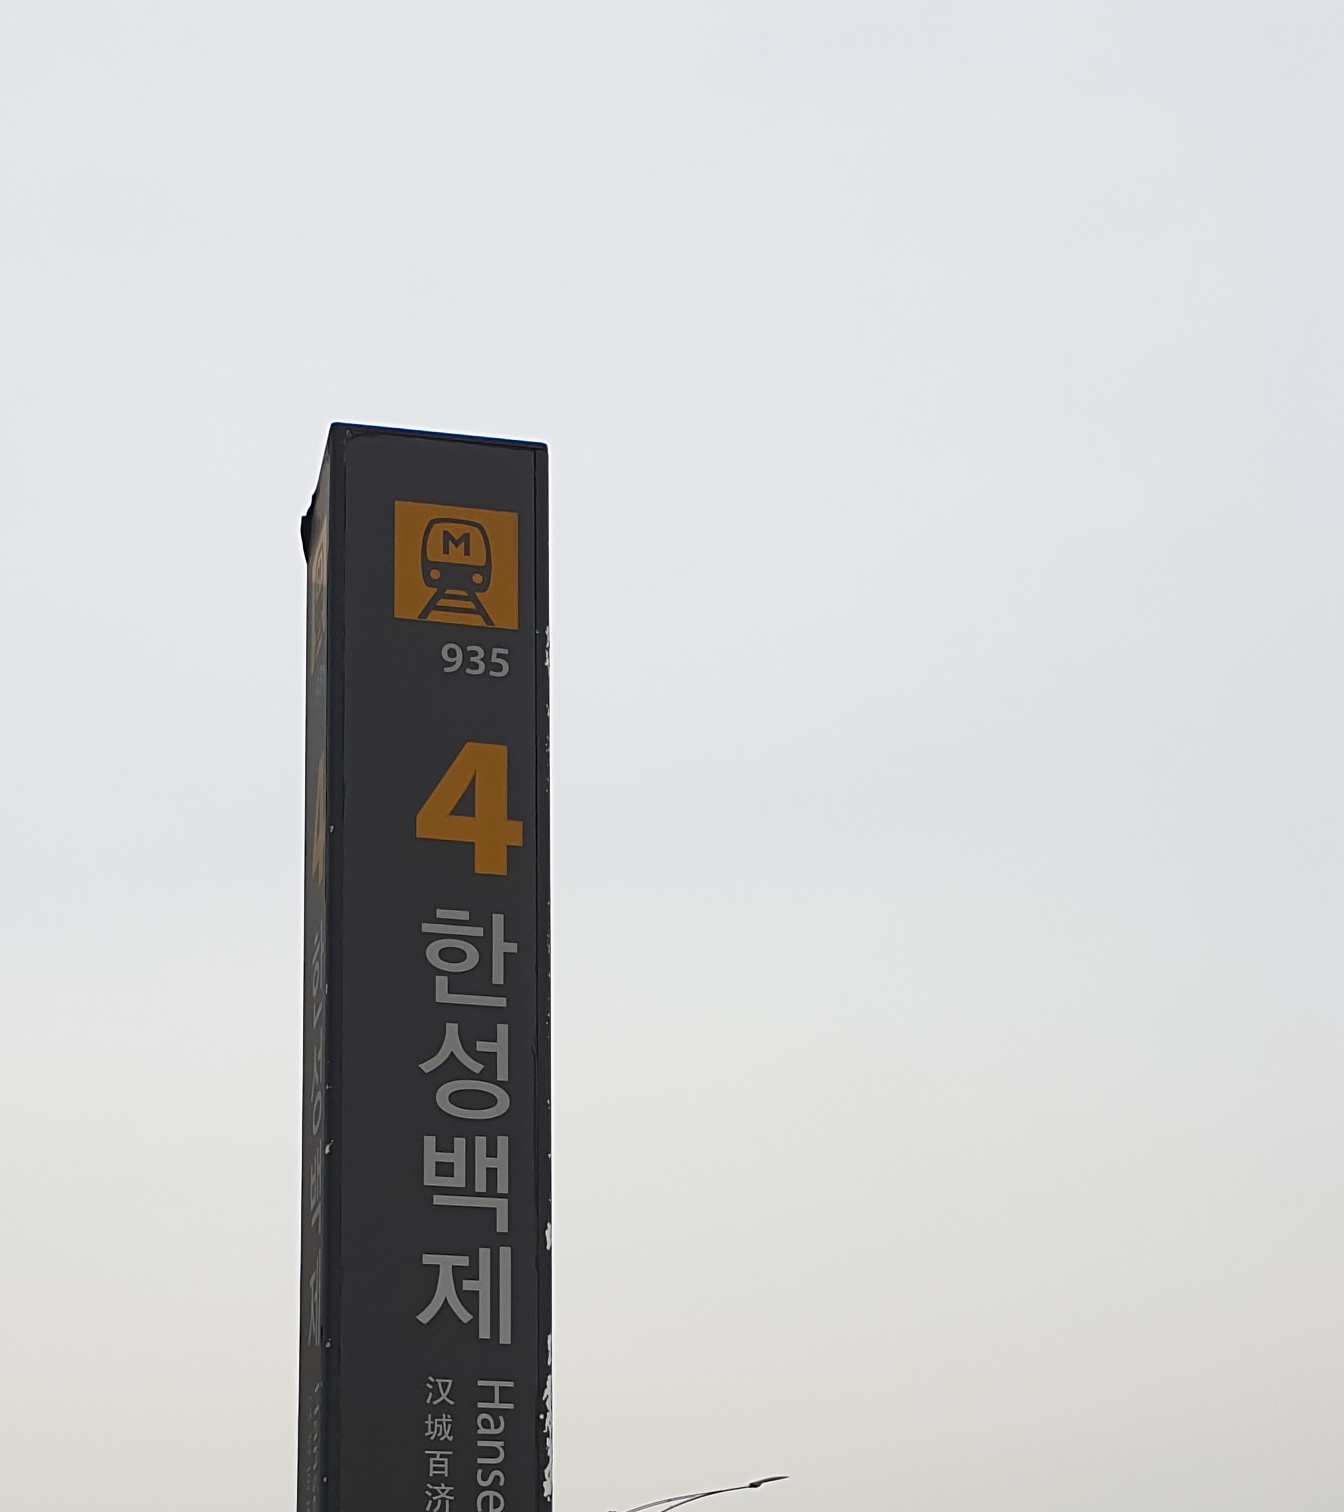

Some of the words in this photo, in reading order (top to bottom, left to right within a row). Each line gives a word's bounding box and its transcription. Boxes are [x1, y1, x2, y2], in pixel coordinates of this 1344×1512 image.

[442, 530, 471, 558] M
[441, 641, 510, 678] 935
[416, 741, 523, 876] 4
[416, 908, 518, 1344] 한성백제
